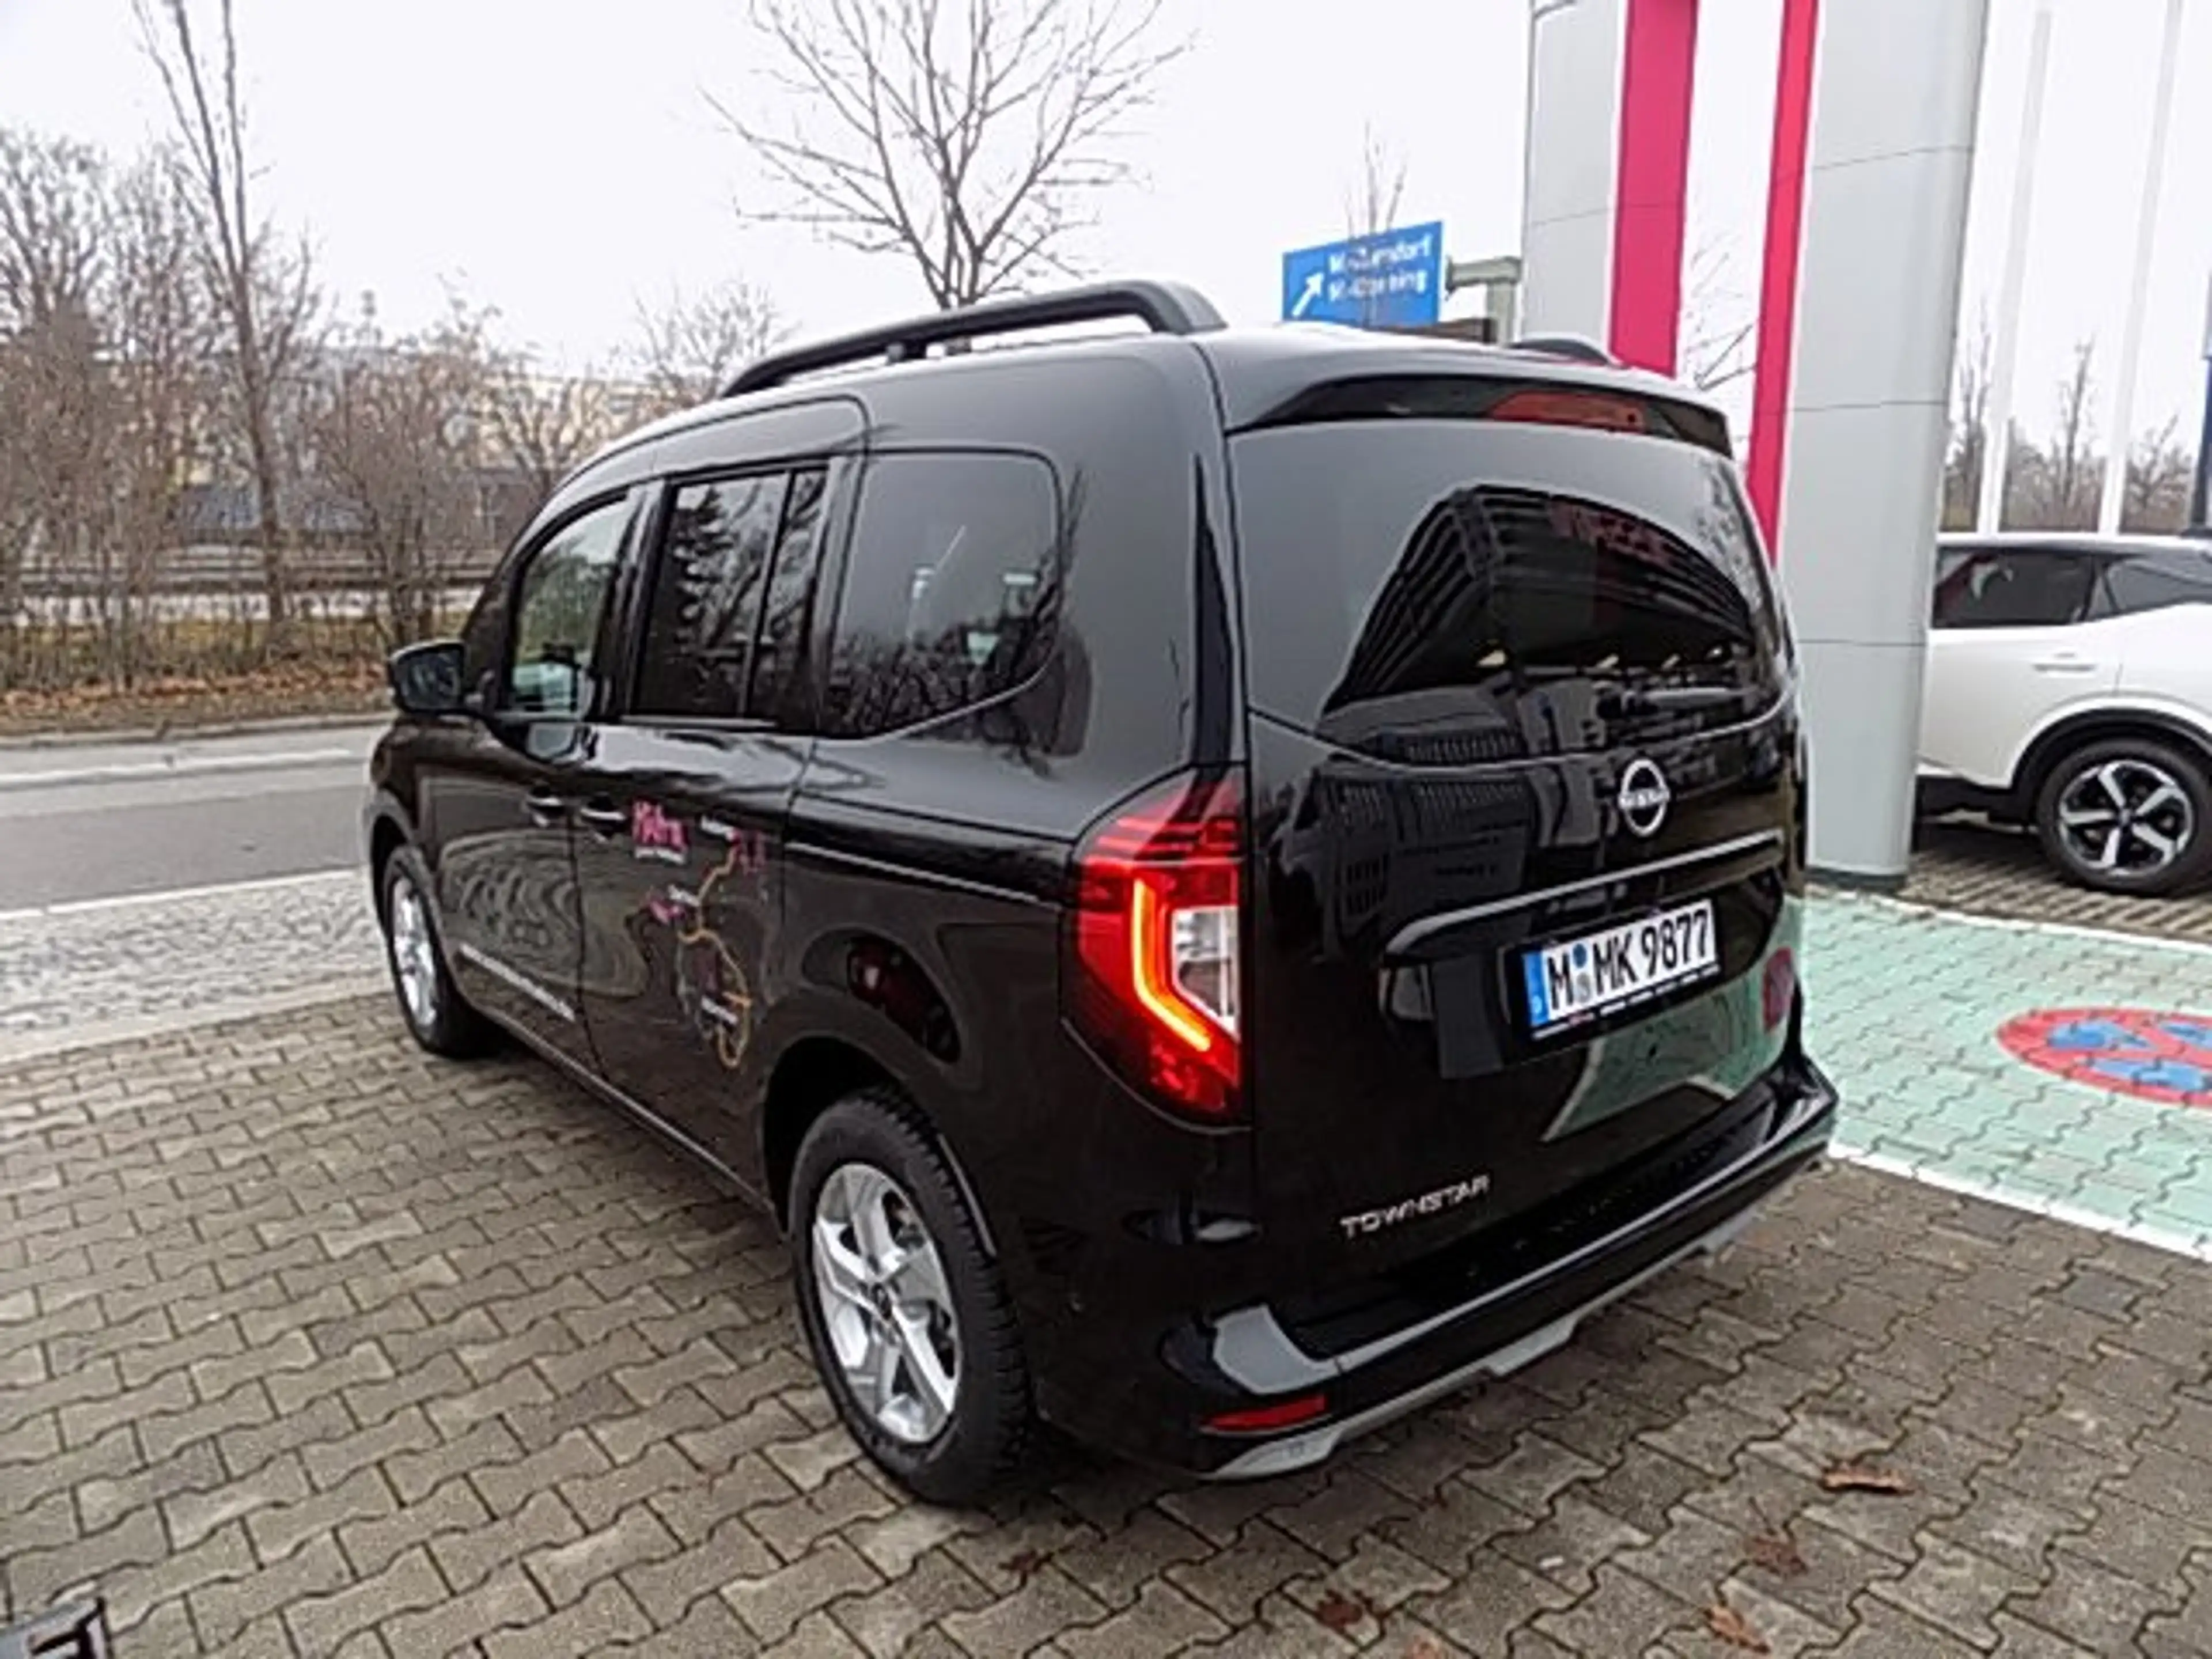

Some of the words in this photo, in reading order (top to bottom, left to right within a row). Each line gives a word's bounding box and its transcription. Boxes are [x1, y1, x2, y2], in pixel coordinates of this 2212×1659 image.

[1546, 952, 1574, 1010] M
[1593, 931, 1639, 995] MK
[1641, 908, 1709, 979] 9877
[1339, 1173, 1490, 1239] TOWNSTAR
